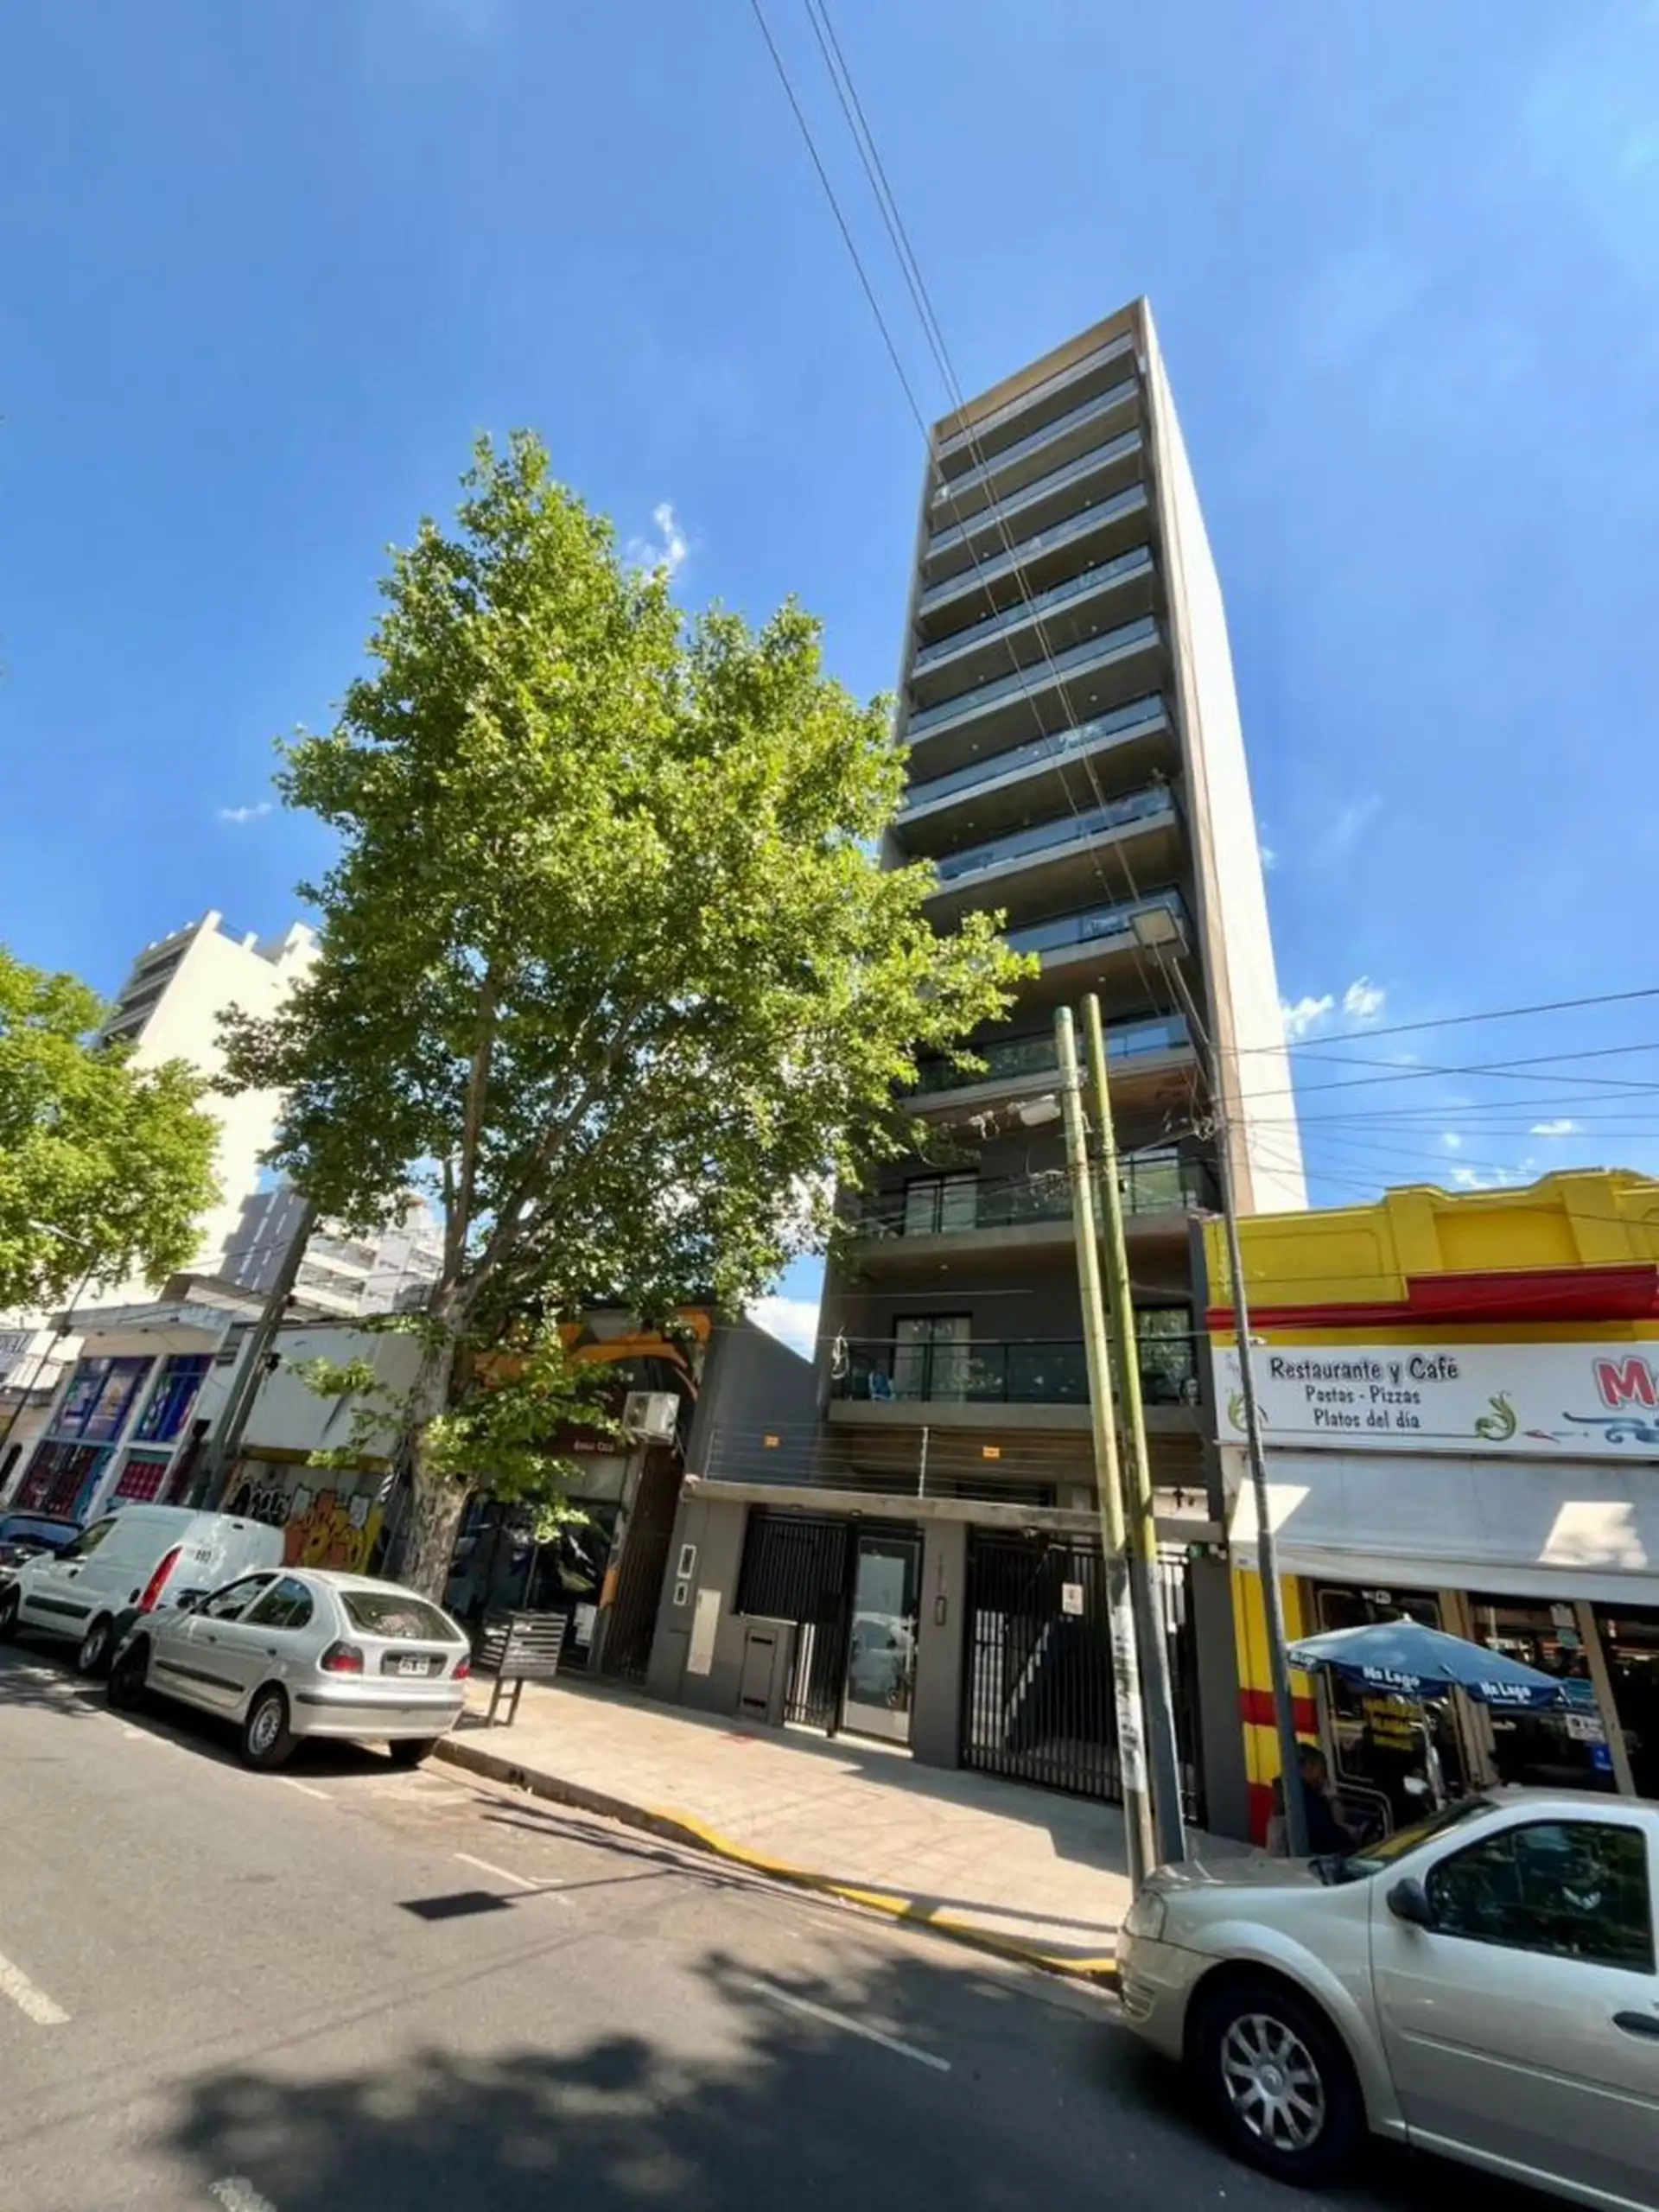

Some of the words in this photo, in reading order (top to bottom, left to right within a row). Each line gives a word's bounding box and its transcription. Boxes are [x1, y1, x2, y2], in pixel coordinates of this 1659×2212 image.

[1270, 1357, 1382, 1380] Restaurante
[1389, 1362, 1401, 1383] y
[1409, 1356, 1459, 1380] Café
[1305, 1384, 1355, 1403] Pastas
[1369, 1384, 1421, 1404] Pizzas
[1313, 1408, 1361, 1427] Platos
[1366, 1409, 1389, 1428] del
